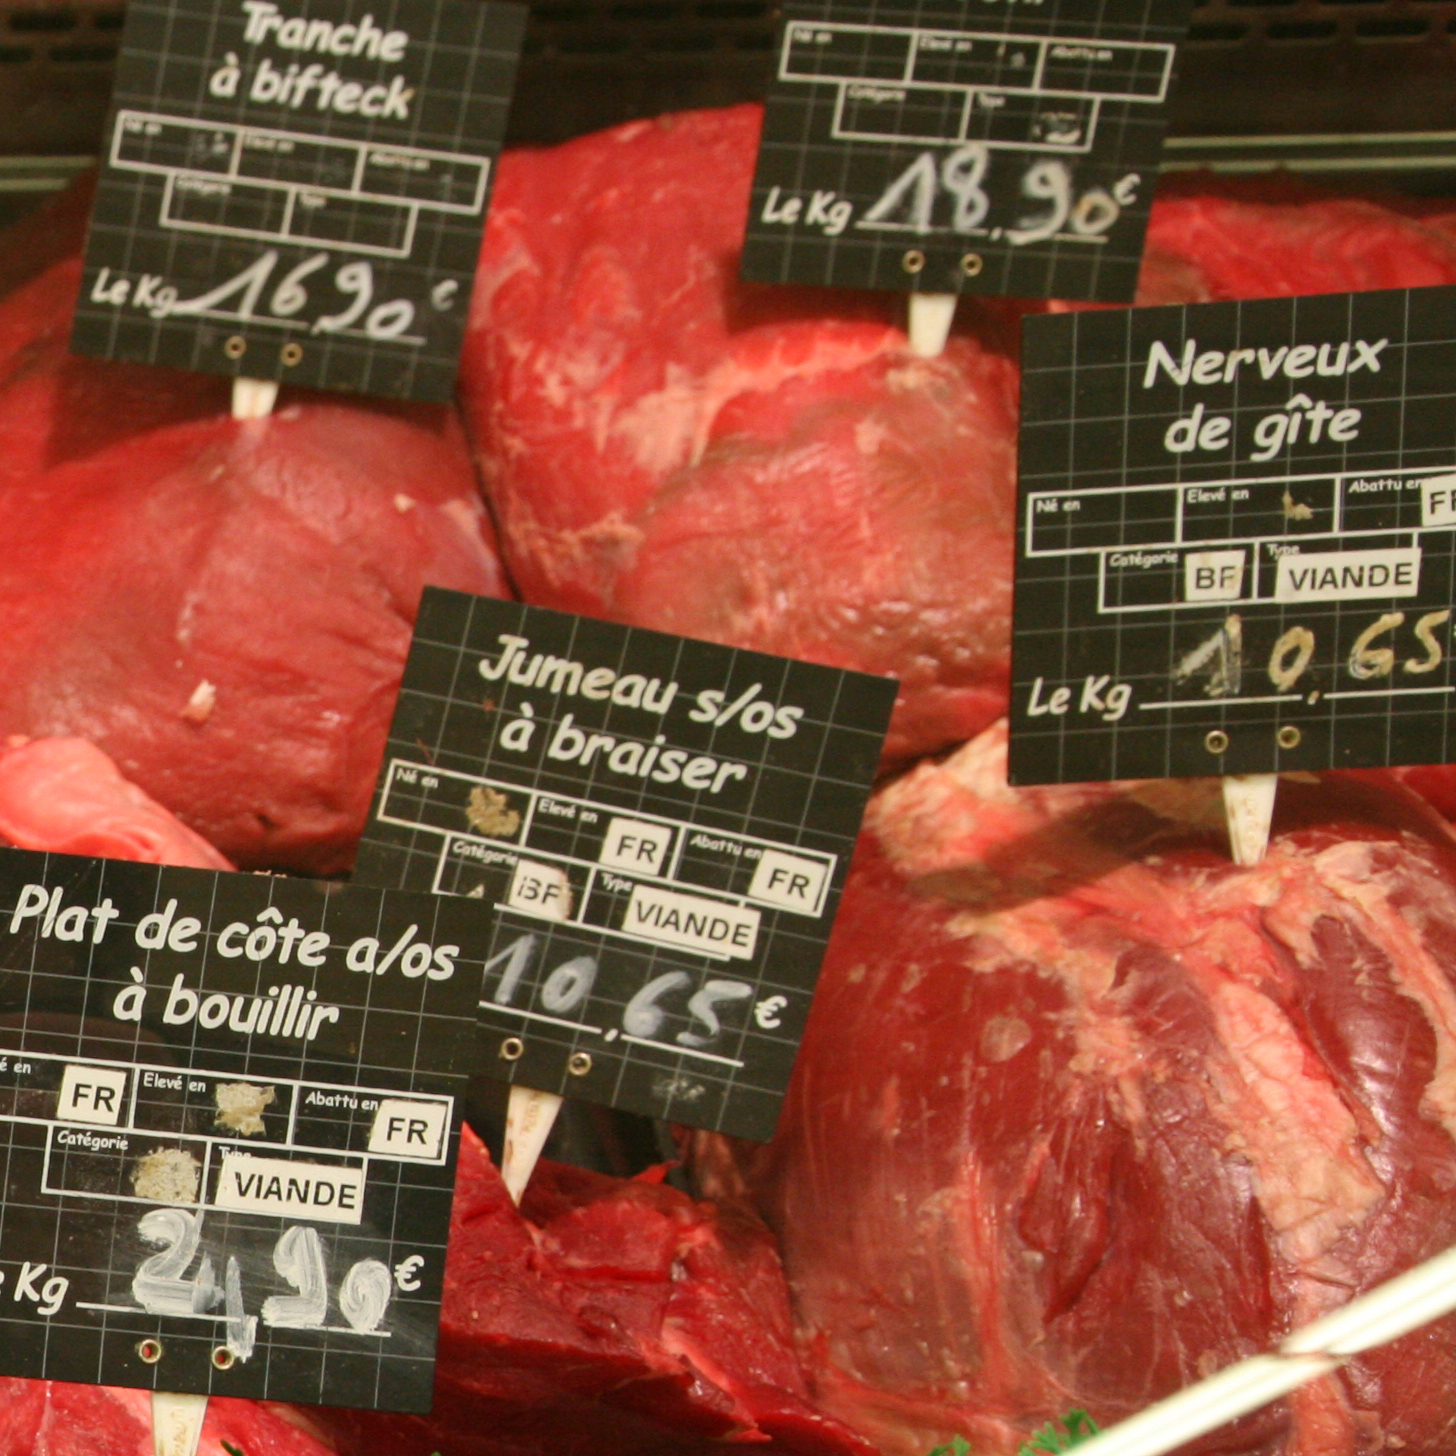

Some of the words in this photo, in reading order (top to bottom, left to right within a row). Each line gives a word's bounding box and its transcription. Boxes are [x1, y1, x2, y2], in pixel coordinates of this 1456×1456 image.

[242, 1, 409, 62] Tranche
[210, 52, 240, 97] à
[251, 59, 414, 119] bifteck
[761, 187, 799, 224] Le
[807, 190, 852, 235] Kg
[91, 267, 129, 303] Le
[132, 273, 177, 319] Kg
[1142, 338, 1388, 388] Nerveux
[1164, 404, 1231, 453] de
[1250, 394, 1362, 462] gîte
[1195, 566, 1237, 590] BF
[1288, 562, 1414, 592] VIANDE
[479, 633, 679, 715] Jumeau
[689, 683, 805, 739] s/os
[1027, 677, 1070, 717] Le
[1079, 674, 1132, 721] Kg
[499, 702, 535, 753] à
[548, 714, 747, 794] braiser
[617, 835, 658, 863] FR
[691, 833, 743, 856] Abattu
[768, 868, 812, 899] FR
[10, 884, 119, 945] Plat
[135, 898, 203, 952] de
[217, 906, 331, 967] côte
[346, 924, 460, 981] a/os
[601, 872, 634, 893] Type
[636, 900, 753, 947] VIANDE
[113, 967, 145, 1022] à
[163, 973, 340, 1041] bouillir
[13, 1060, 32, 1075] en
[72, 1083, 116, 1113] FR
[143, 1072, 183, 1091] Elevé
[188, 1078, 207, 1093] en
[57, 1130, 130, 1153] Catégorie
[305, 1090, 360, 1110] Abattu
[361, 1096, 379, 1112] en
[385, 1117, 430, 1145] FR
[235, 1171, 357, 1210] VIANDE
[14, 1260, 69, 1316] Kg
